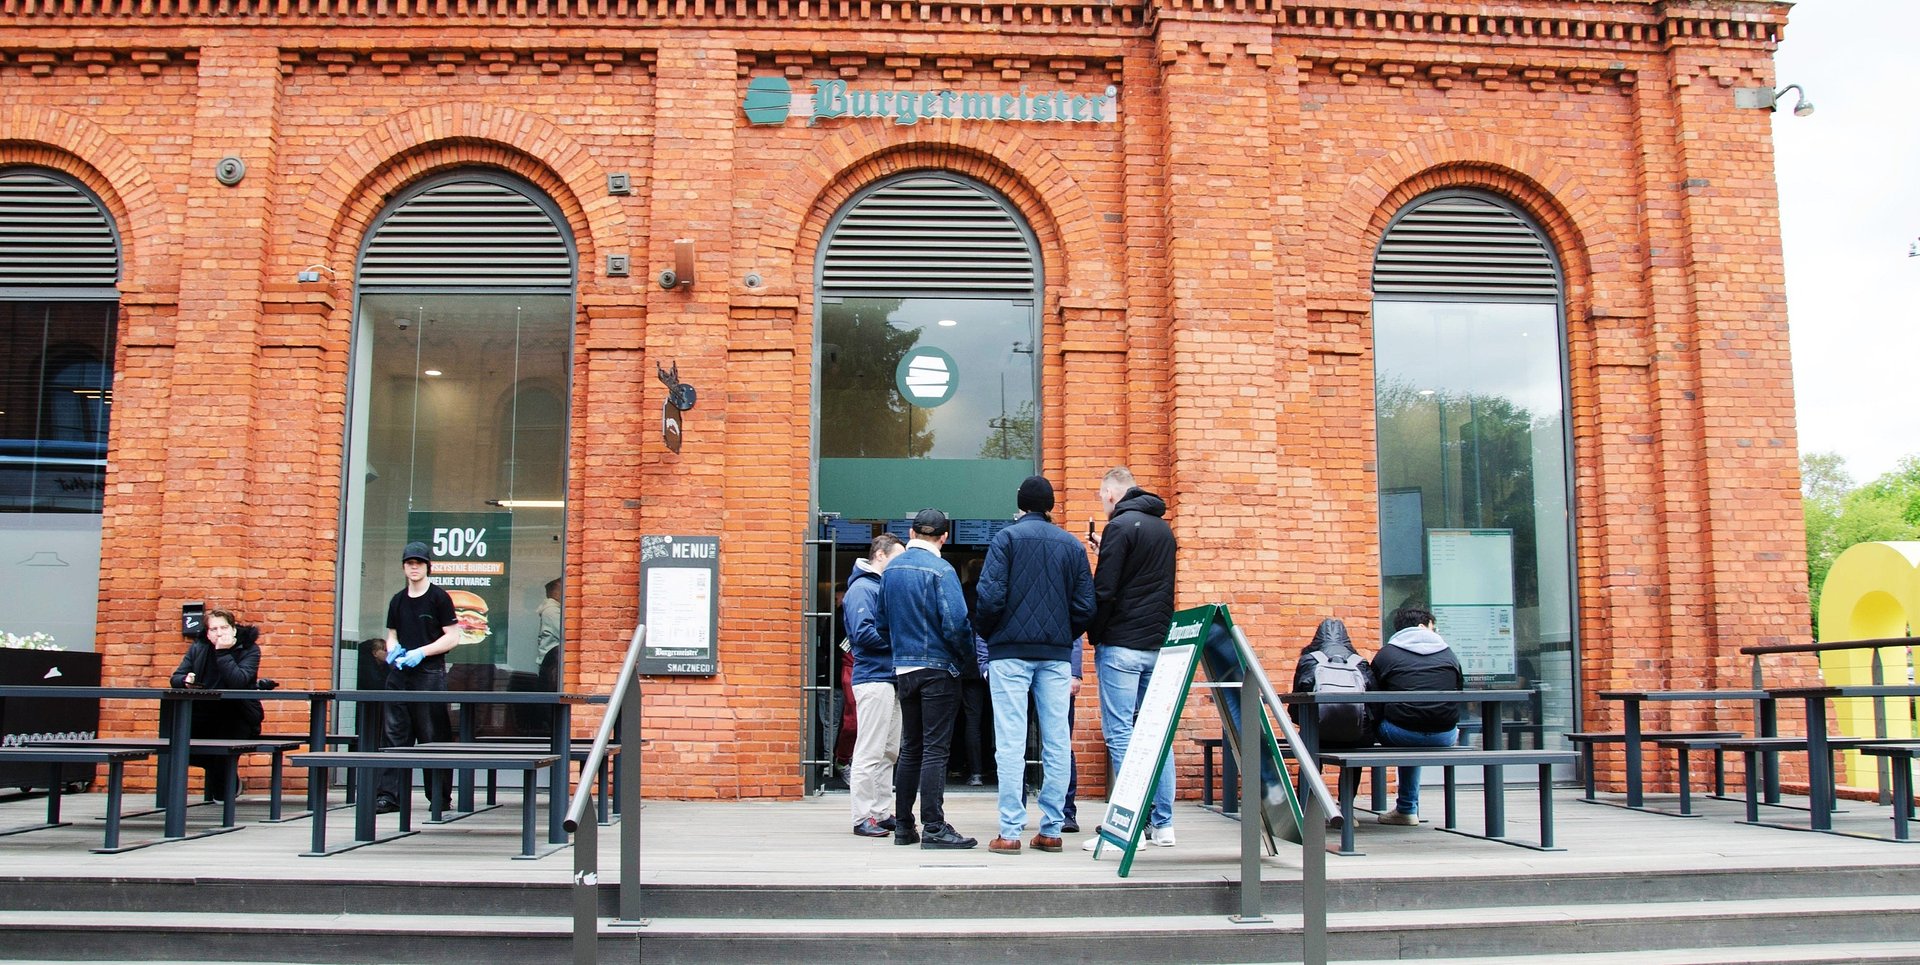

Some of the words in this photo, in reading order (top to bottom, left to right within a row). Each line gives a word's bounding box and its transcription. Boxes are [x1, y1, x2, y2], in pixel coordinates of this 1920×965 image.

[432, 527, 487, 557] 50%
[672, 543, 708, 558] MENU
[468, 563, 500, 573] BURGERY
[455, 577, 491, 587] OTWARCIE
[655, 648, 698, 657] Burgermeister
